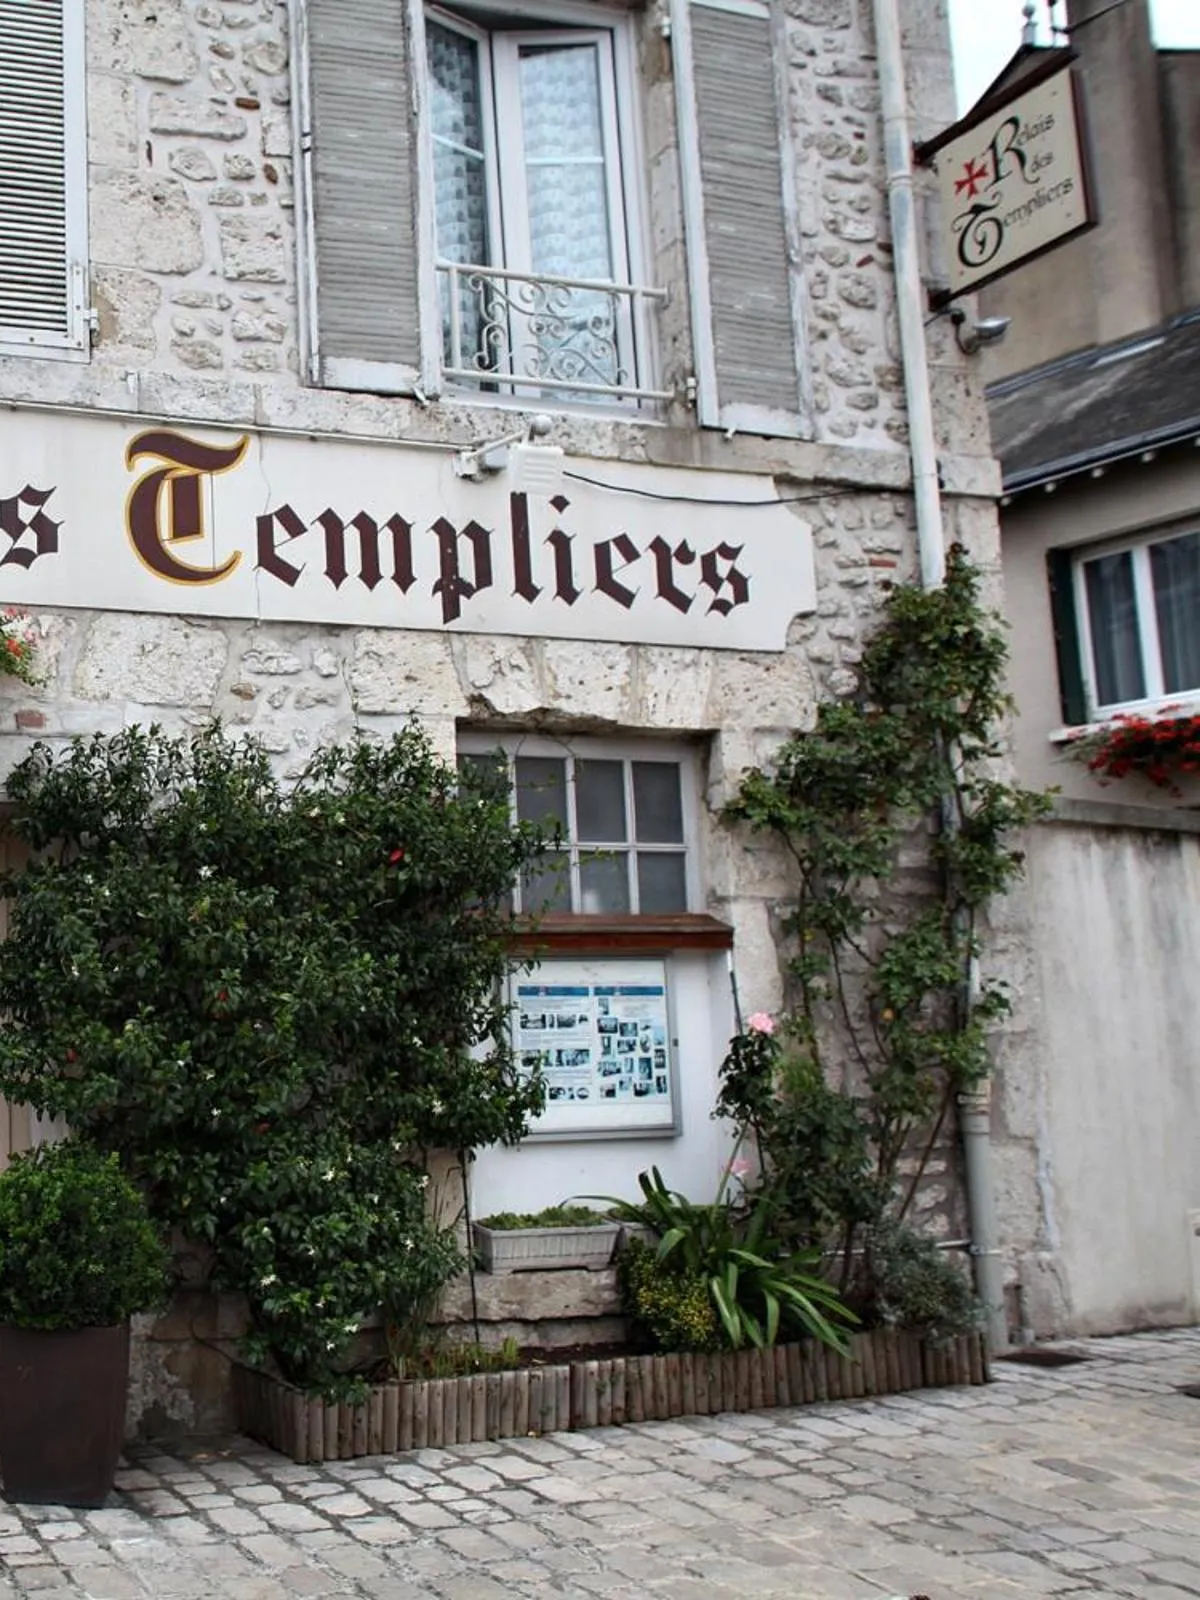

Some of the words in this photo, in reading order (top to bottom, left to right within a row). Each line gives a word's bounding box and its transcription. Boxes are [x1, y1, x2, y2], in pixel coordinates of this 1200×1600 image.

[981, 114, 1055, 192] Relais
[1030, 152, 1053, 174] des
[951, 178, 1074, 267] Templiers
[124, 428, 751, 626] Templiers
